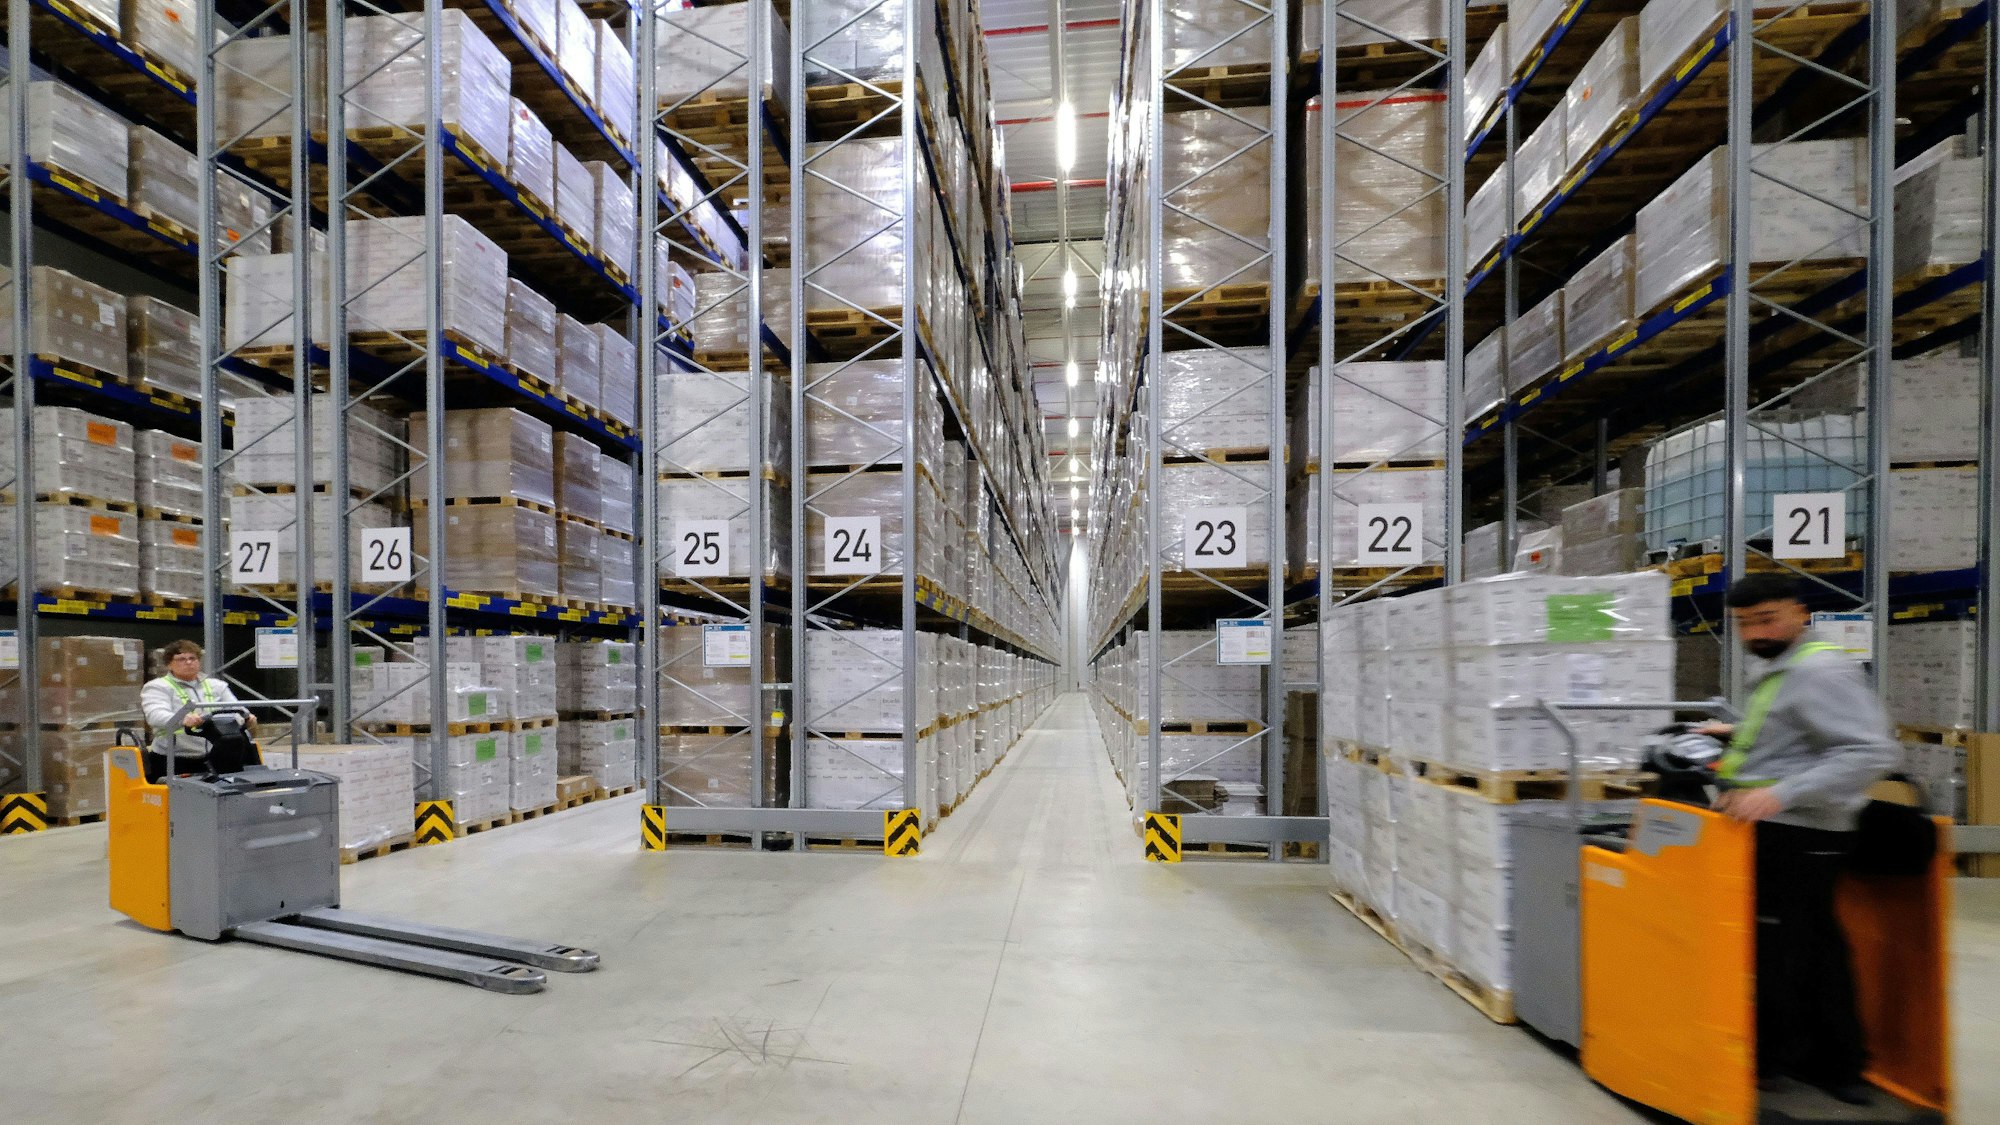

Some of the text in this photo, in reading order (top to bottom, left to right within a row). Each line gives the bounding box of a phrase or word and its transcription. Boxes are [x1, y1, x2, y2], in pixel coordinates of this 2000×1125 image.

[1195, 520, 1236, 556] 23
[1368, 515, 1412, 553] 22
[1788, 506, 1830, 545] 21
[239, 541, 271, 573] 27
[369, 538, 402, 571] 26
[683, 531, 720, 565] 25
[833, 528, 872, 563] 24
